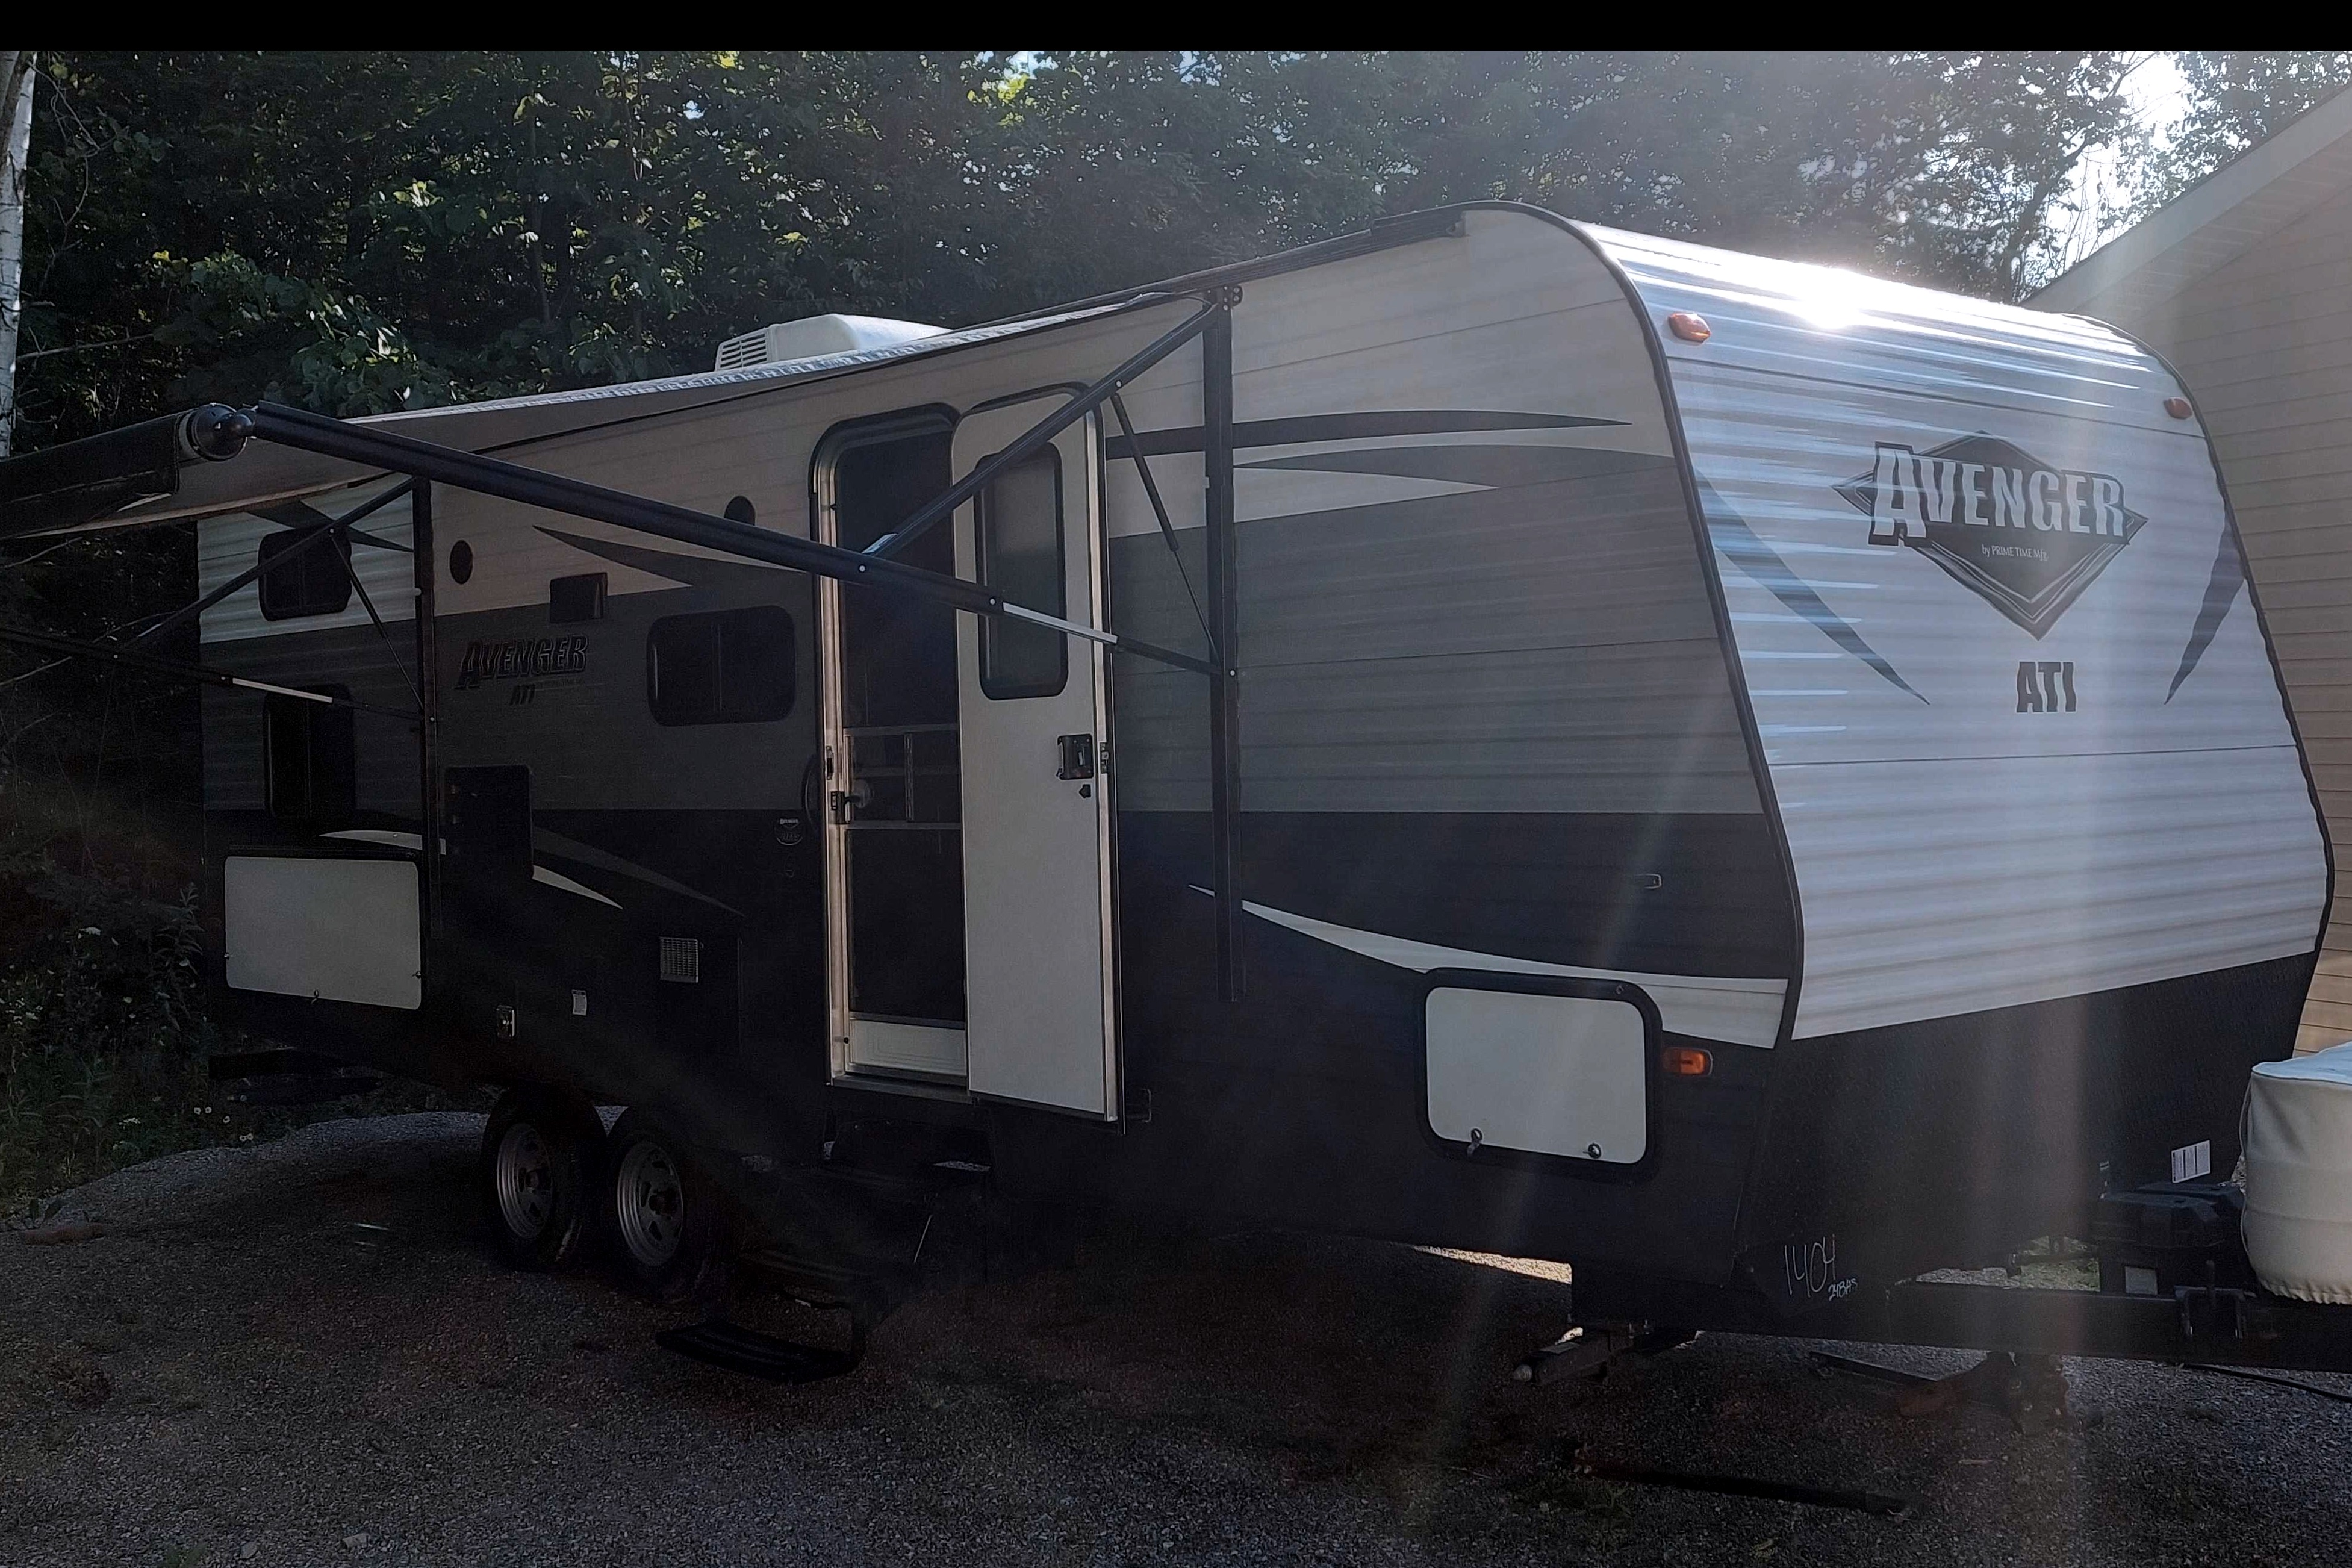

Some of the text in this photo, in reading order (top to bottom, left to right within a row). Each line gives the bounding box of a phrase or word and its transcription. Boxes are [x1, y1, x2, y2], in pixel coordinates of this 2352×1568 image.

[1870, 442, 2127, 542] AVENGER
[1981, 543, 1990, 558] by
[1992, 545, 2014, 556] PRIME
[2015, 547, 2033, 558] TIME
[455, 635, 588, 689] AVENGER
[2016, 661, 2077, 712] ATI
[1784, 1234, 1835, 1298] 1404
